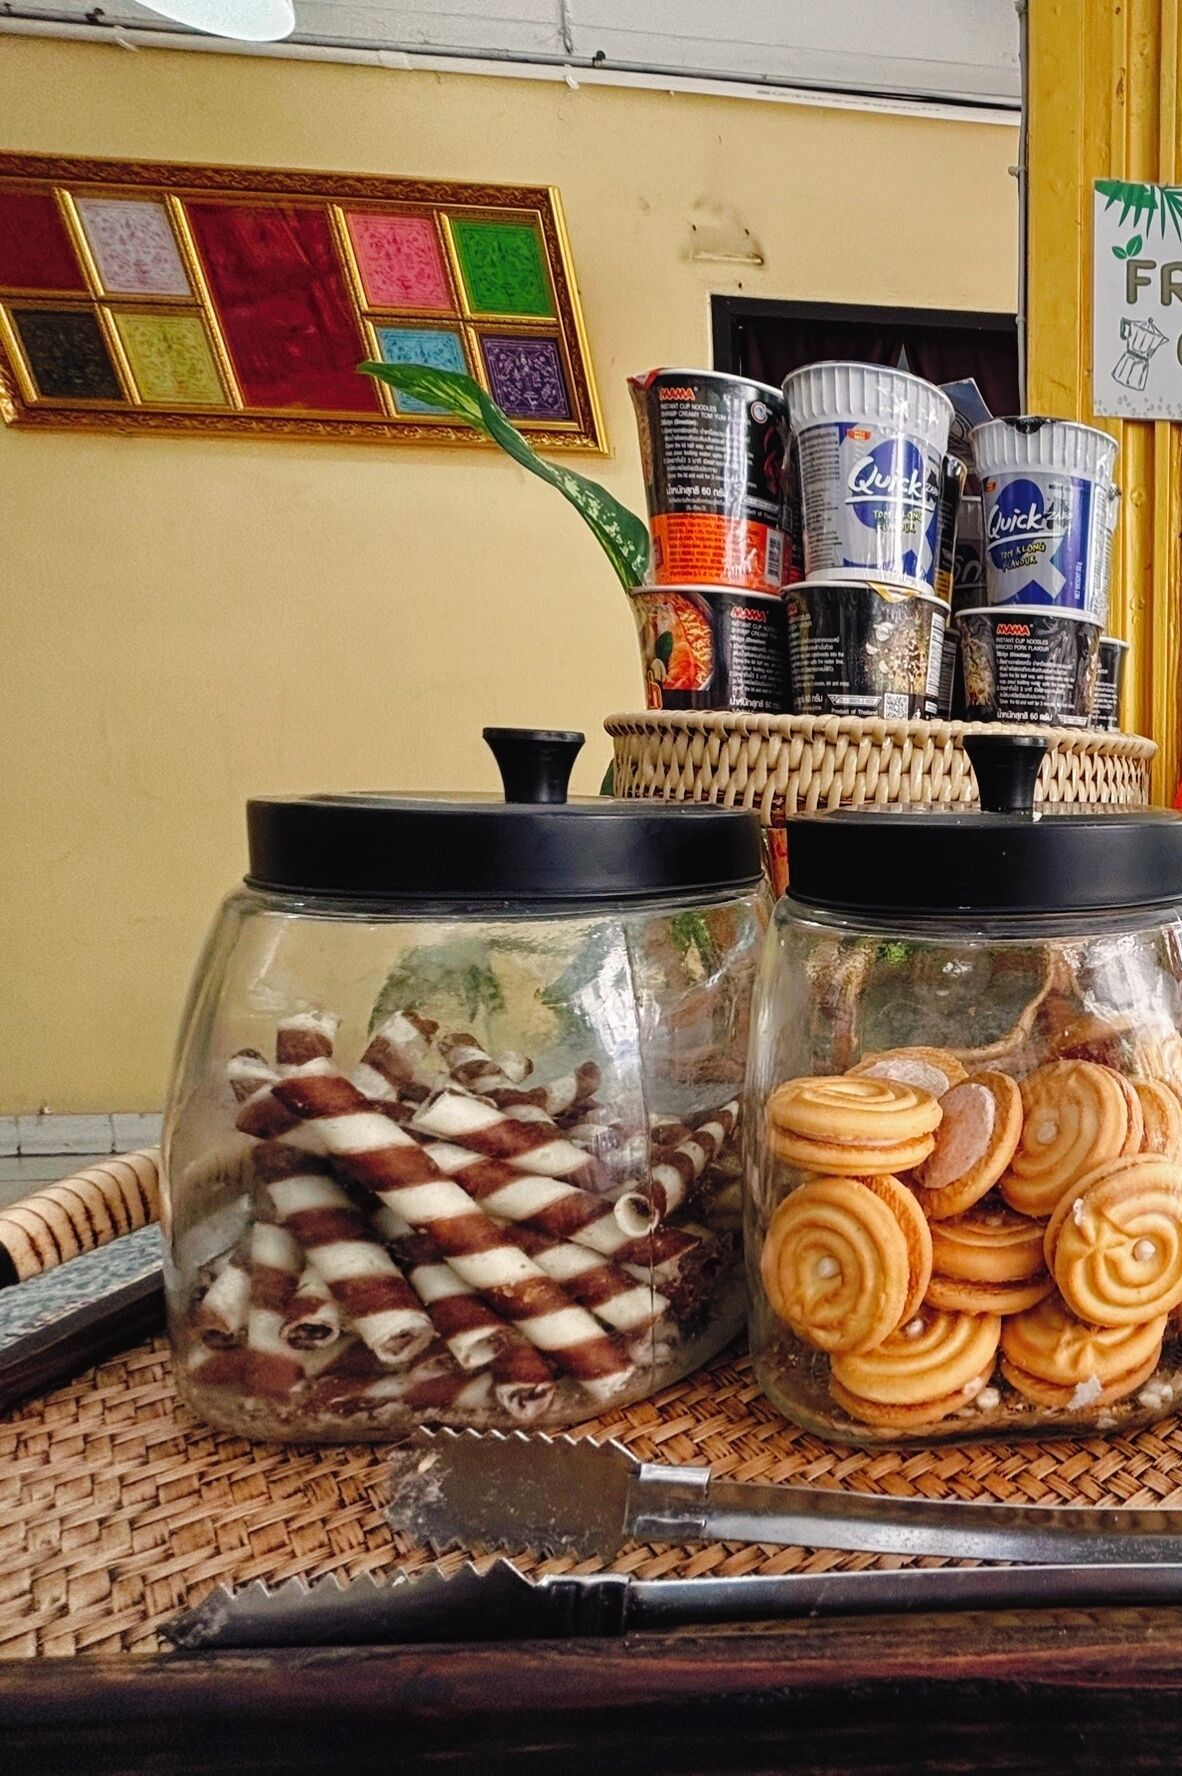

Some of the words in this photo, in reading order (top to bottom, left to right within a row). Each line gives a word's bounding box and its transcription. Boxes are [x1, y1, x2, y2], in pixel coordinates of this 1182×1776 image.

[659, 387, 696, 401] MAMA
[680, 402, 691, 410] CUP
[691, 404, 717, 412] NOODLES
[701, 411, 713, 419] TOM
[714, 413, 727, 421] YUM
[847, 455, 923, 498] Quick
[701, 487, 712, 496] 60
[987, 502, 1043, 539] Quick
[1001, 549, 1014, 560] TOM
[1016, 542, 1047, 553] KLONG
[1002, 555, 1038, 572] FLAVOUR
[730, 606, 767, 623] MAMA
[996, 623, 1031, 637] MAMA
[1029, 712, 1039, 721] 60
